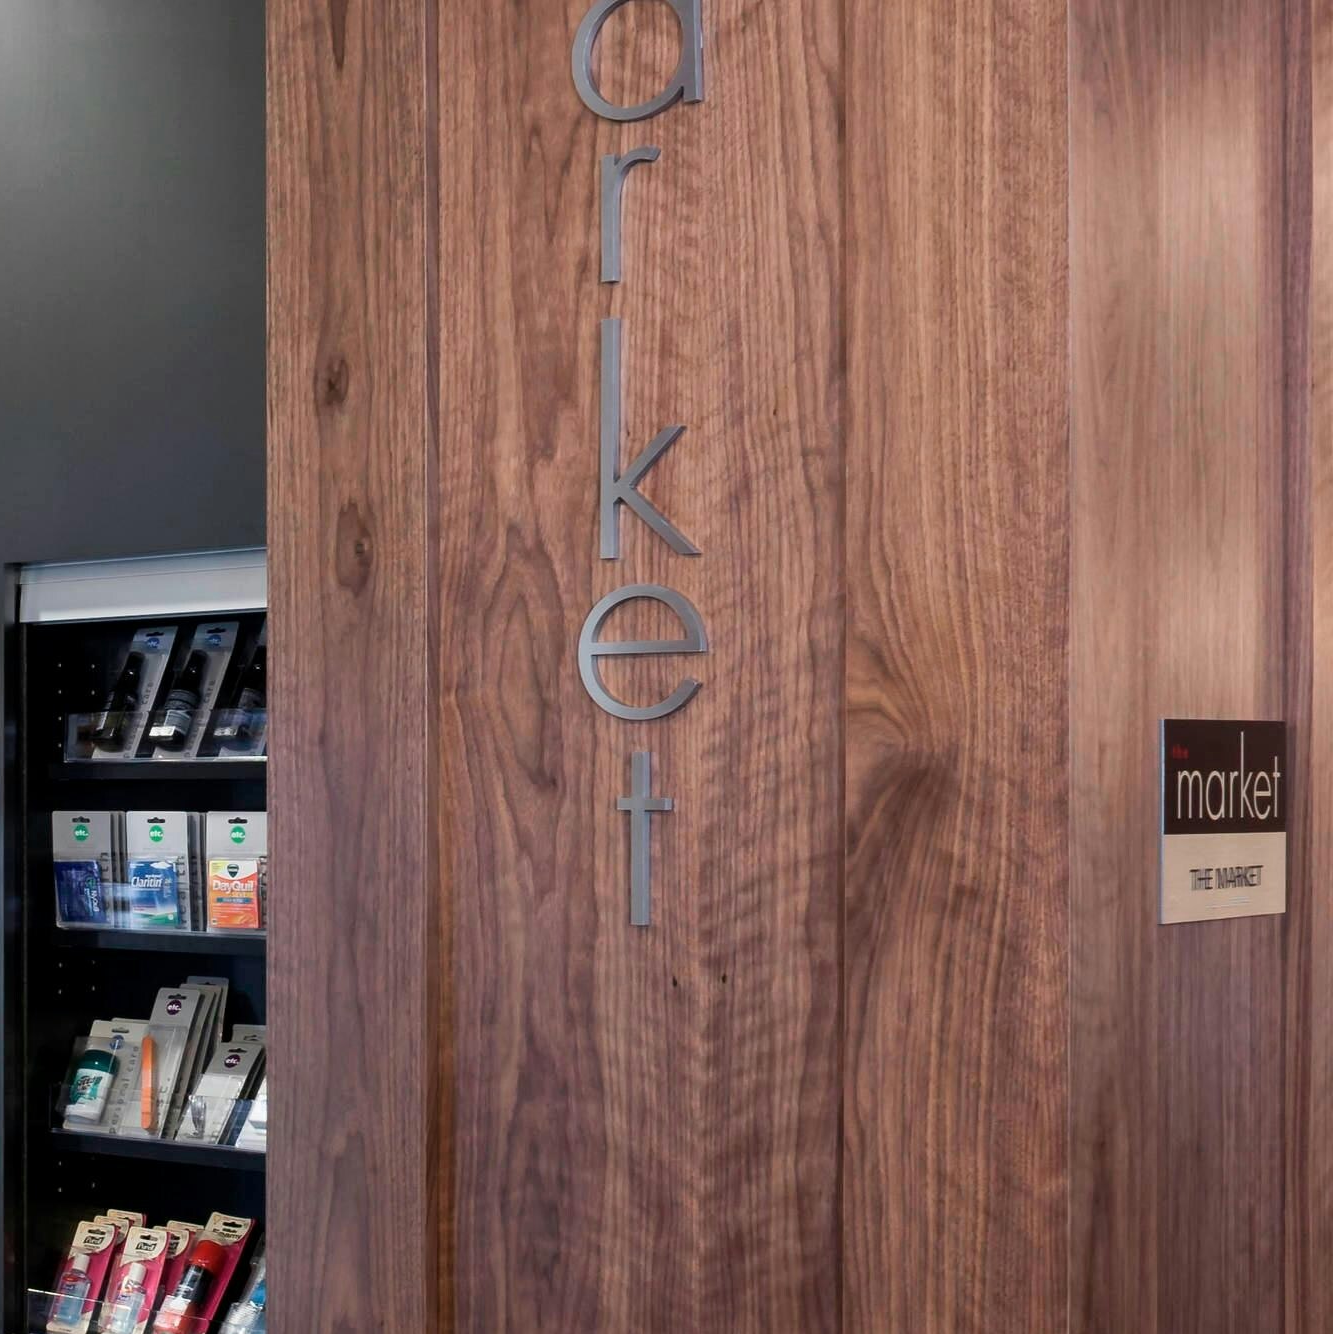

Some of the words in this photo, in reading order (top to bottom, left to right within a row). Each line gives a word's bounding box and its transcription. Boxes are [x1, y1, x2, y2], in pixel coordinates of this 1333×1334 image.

[1176, 731, 1281, 820] market
[131, 876, 163, 888] Claritin
[212, 880, 254, 894] DayQuil
[1189, 869, 1213, 891] THE
[1215, 864, 1264, 889] MARKET
